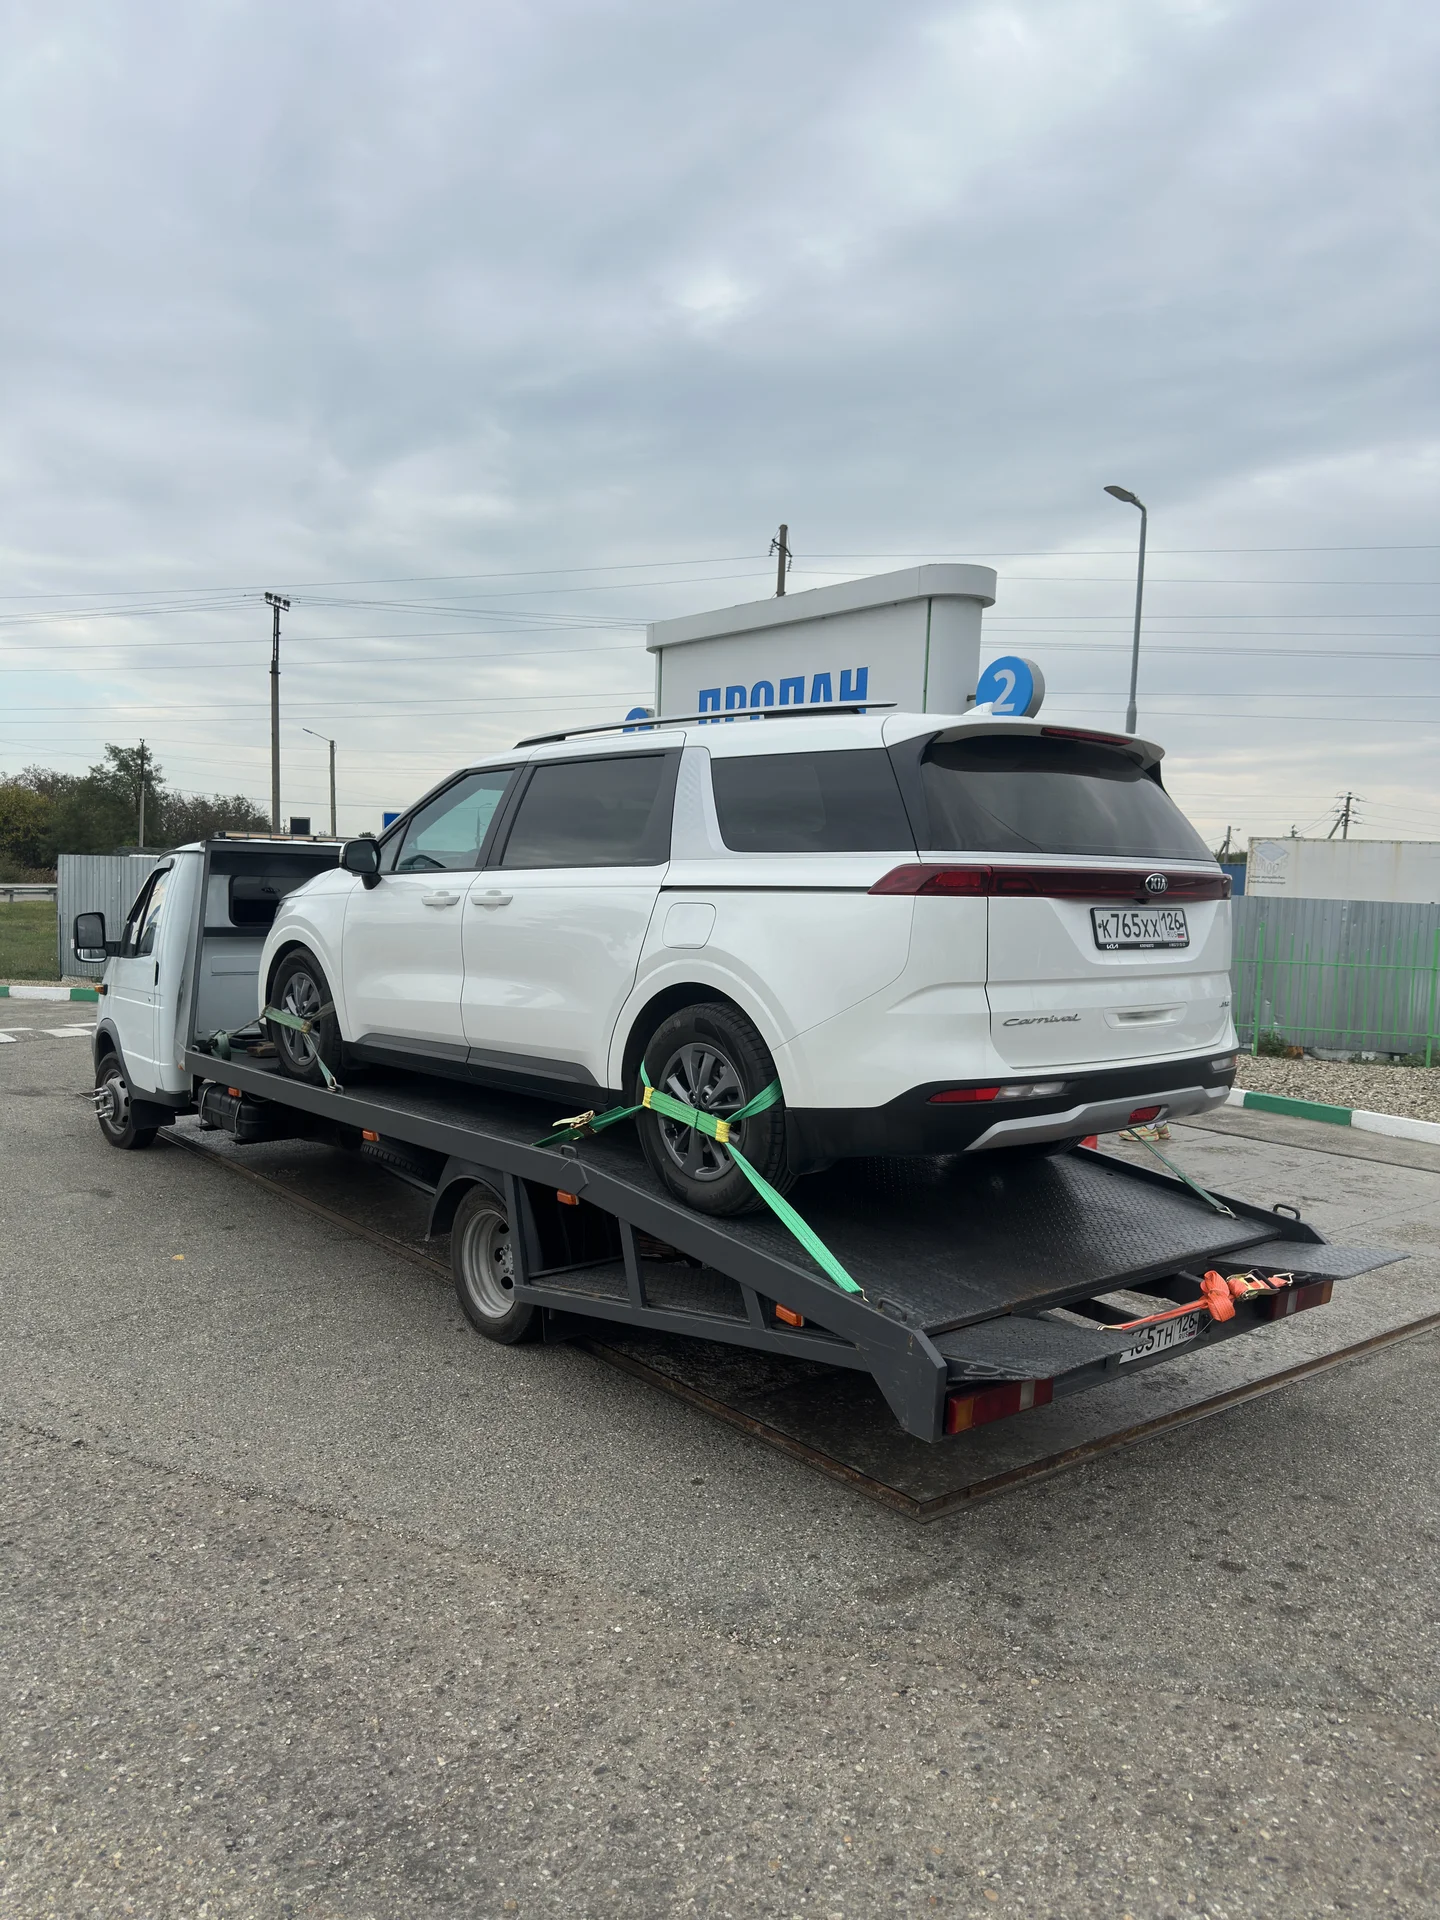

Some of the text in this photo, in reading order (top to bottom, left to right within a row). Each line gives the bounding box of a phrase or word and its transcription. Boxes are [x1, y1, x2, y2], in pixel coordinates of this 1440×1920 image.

[698, 667, 868, 724] ПРОПАН
[991, 669, 1016, 713] 2
[1149, 876, 1167, 891] KIA
[1101, 912, 1180, 938] К765ХХ 126
[1002, 1013, 1082, 1027] Carnival
[1177, 1314, 1195, 1334] 126
